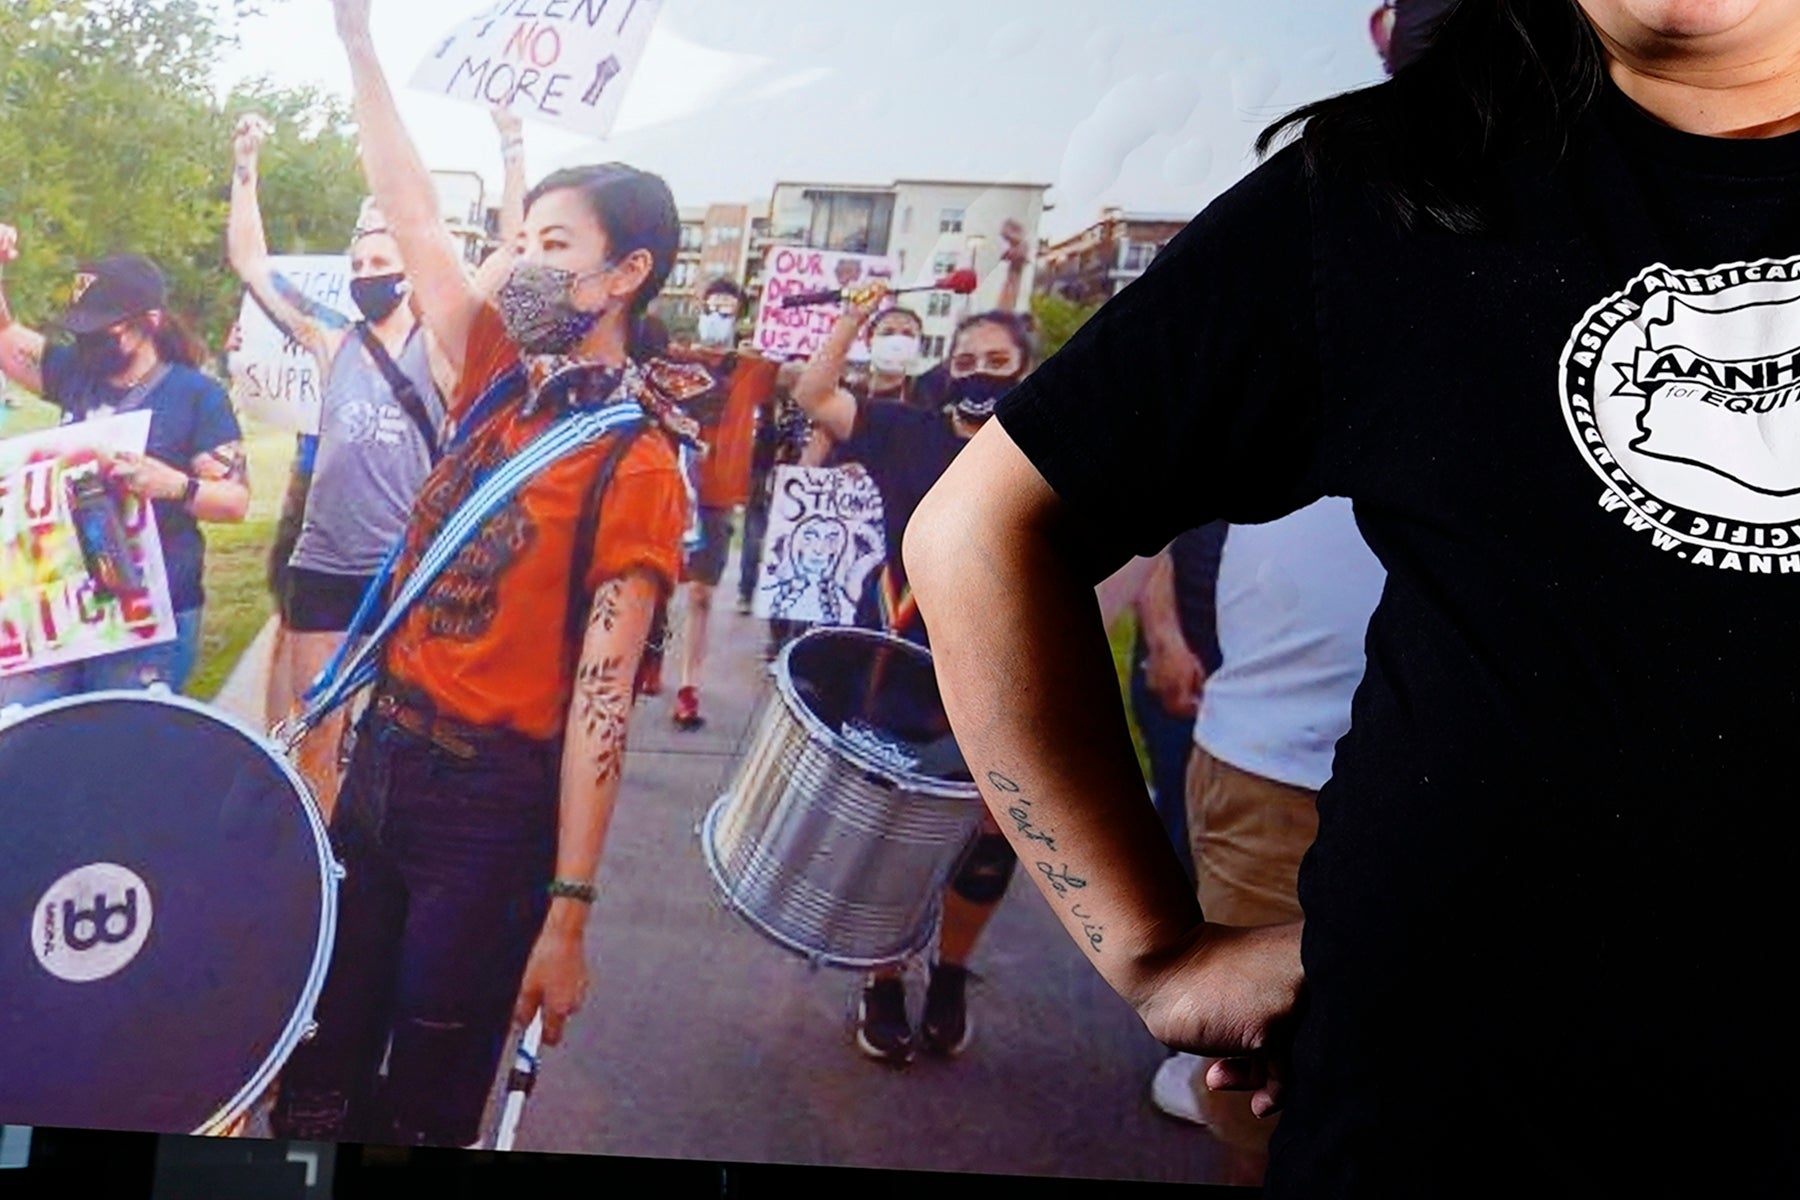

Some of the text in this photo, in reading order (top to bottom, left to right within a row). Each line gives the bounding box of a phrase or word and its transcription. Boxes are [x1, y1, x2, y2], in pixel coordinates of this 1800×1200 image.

[503, 21, 561, 68] NO
[445, 56, 572, 115] MORE
[776, 251, 823, 275] OUR
[761, 329, 791, 348] US
[1572, 298, 1641, 368] ASIAN
[246, 364, 317, 402] SUPR
[1665, 385, 1699, 399] for
